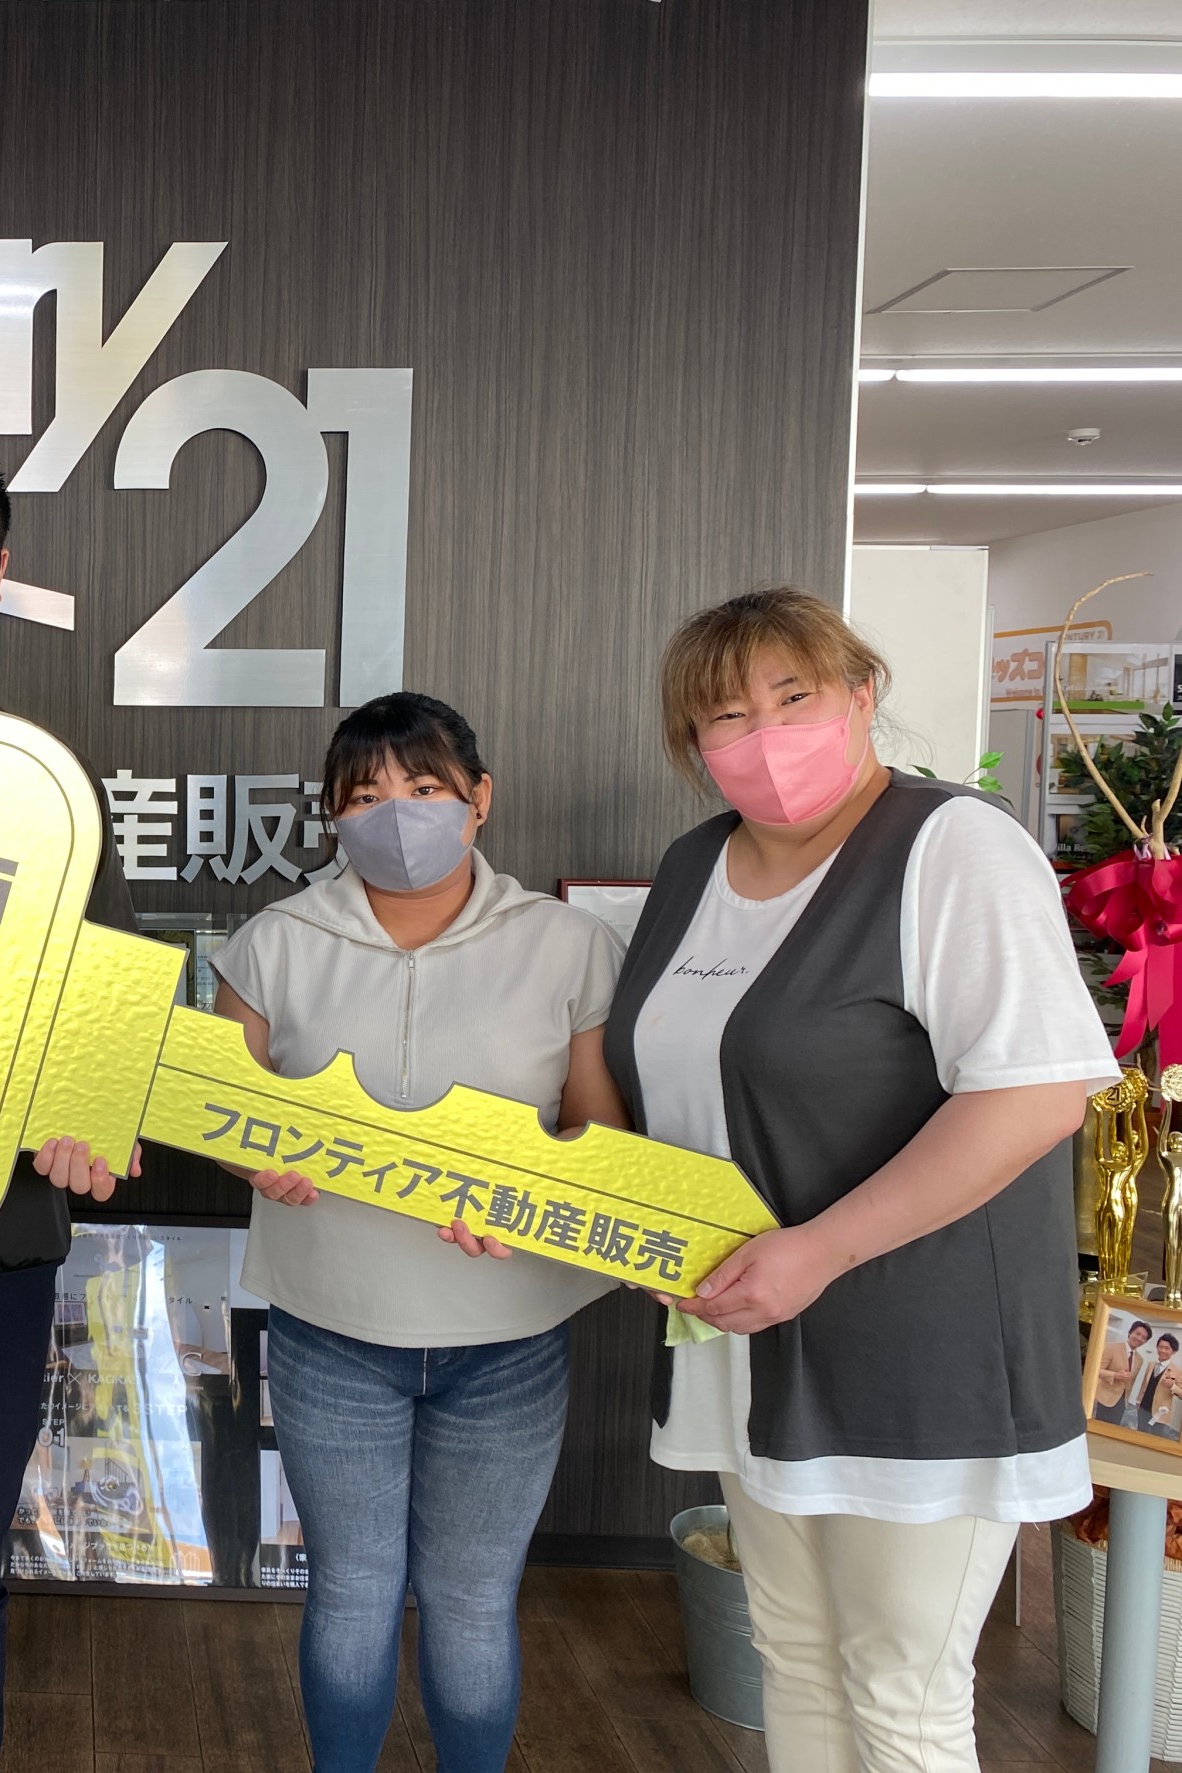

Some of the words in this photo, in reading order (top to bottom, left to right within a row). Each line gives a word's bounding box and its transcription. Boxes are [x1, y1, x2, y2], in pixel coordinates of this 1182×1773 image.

[114, 368, 414, 708] 21
[201, 1101, 689, 1282] フロンティア不動産販売
